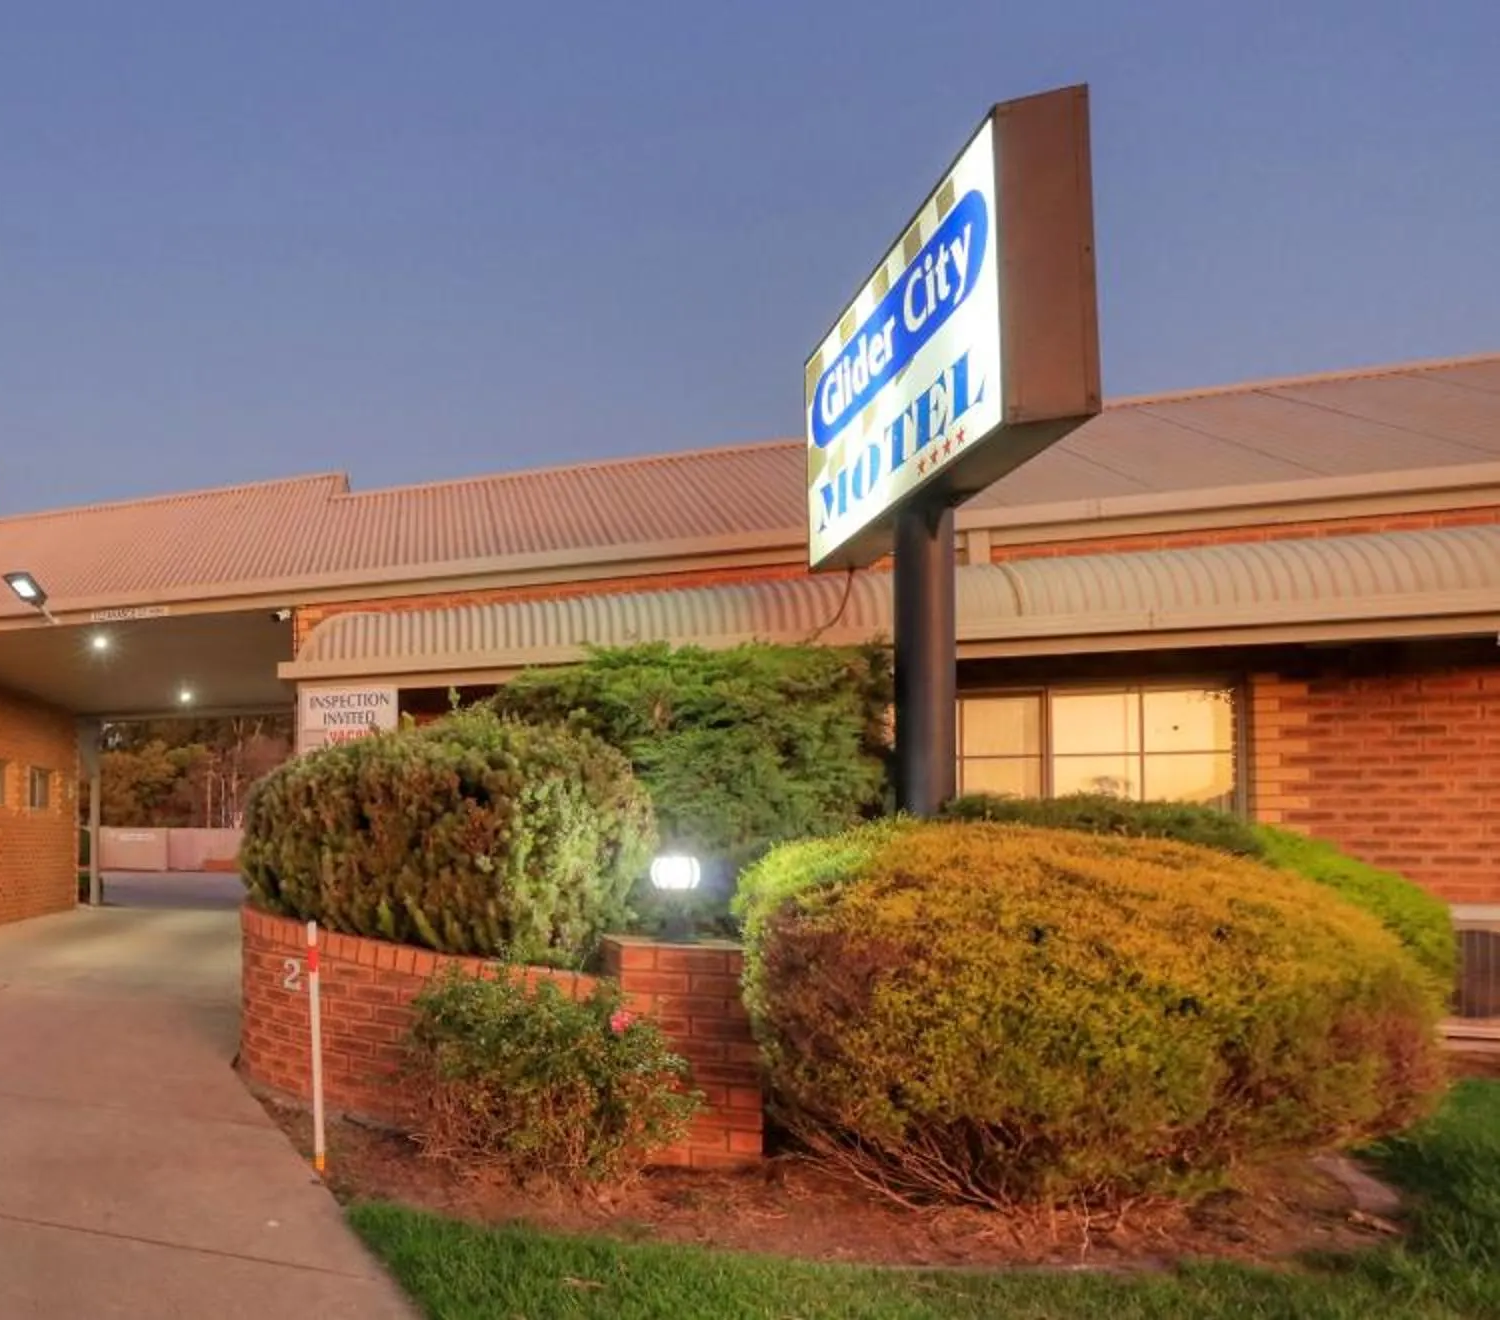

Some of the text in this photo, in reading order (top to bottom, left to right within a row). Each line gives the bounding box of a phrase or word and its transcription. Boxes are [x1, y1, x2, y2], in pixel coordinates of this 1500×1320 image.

[821, 223, 972, 426] Glider City
[818, 348, 987, 534] MOTEL
[309, 692, 390, 709] INSPECTION
[323, 710, 376, 725] INVITED
[283, 958, 301, 992] 2
